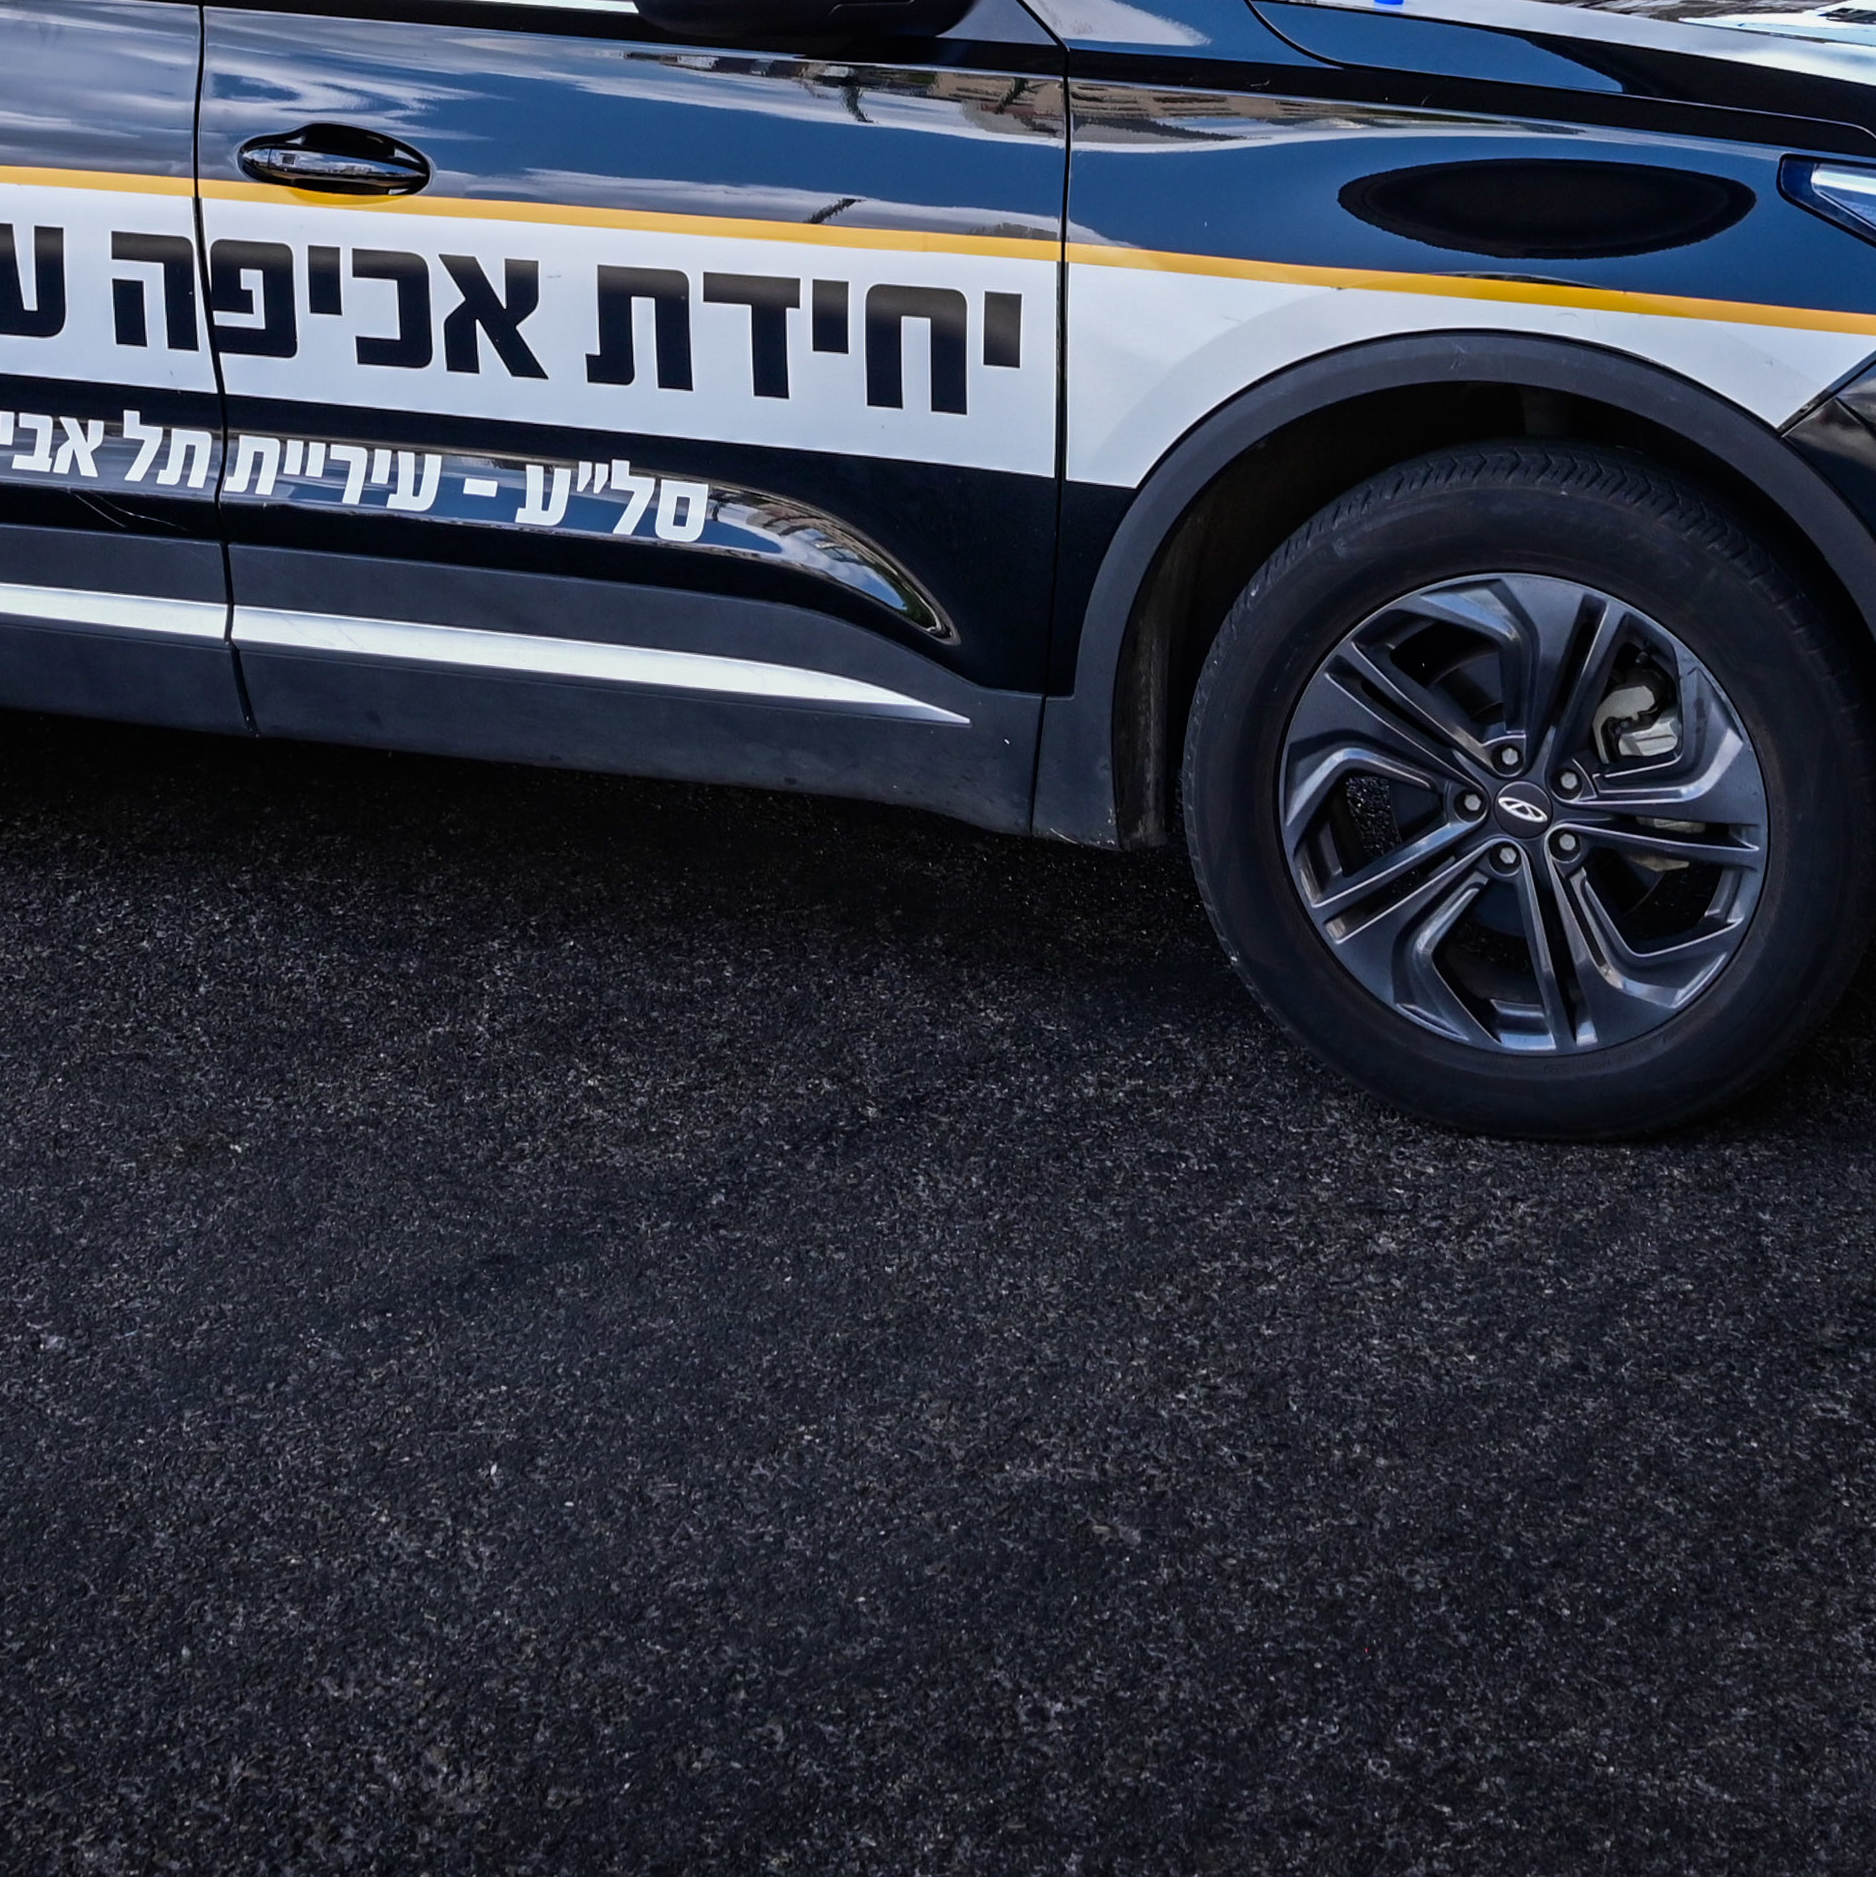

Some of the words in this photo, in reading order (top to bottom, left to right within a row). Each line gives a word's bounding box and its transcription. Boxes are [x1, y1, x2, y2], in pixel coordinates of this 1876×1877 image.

[112, 231, 549, 380] אכיפה
[585, 265, 1023, 415] יחידת
[123, 409, 214, 489] תל
[225, 433, 443, 512] עיריית
